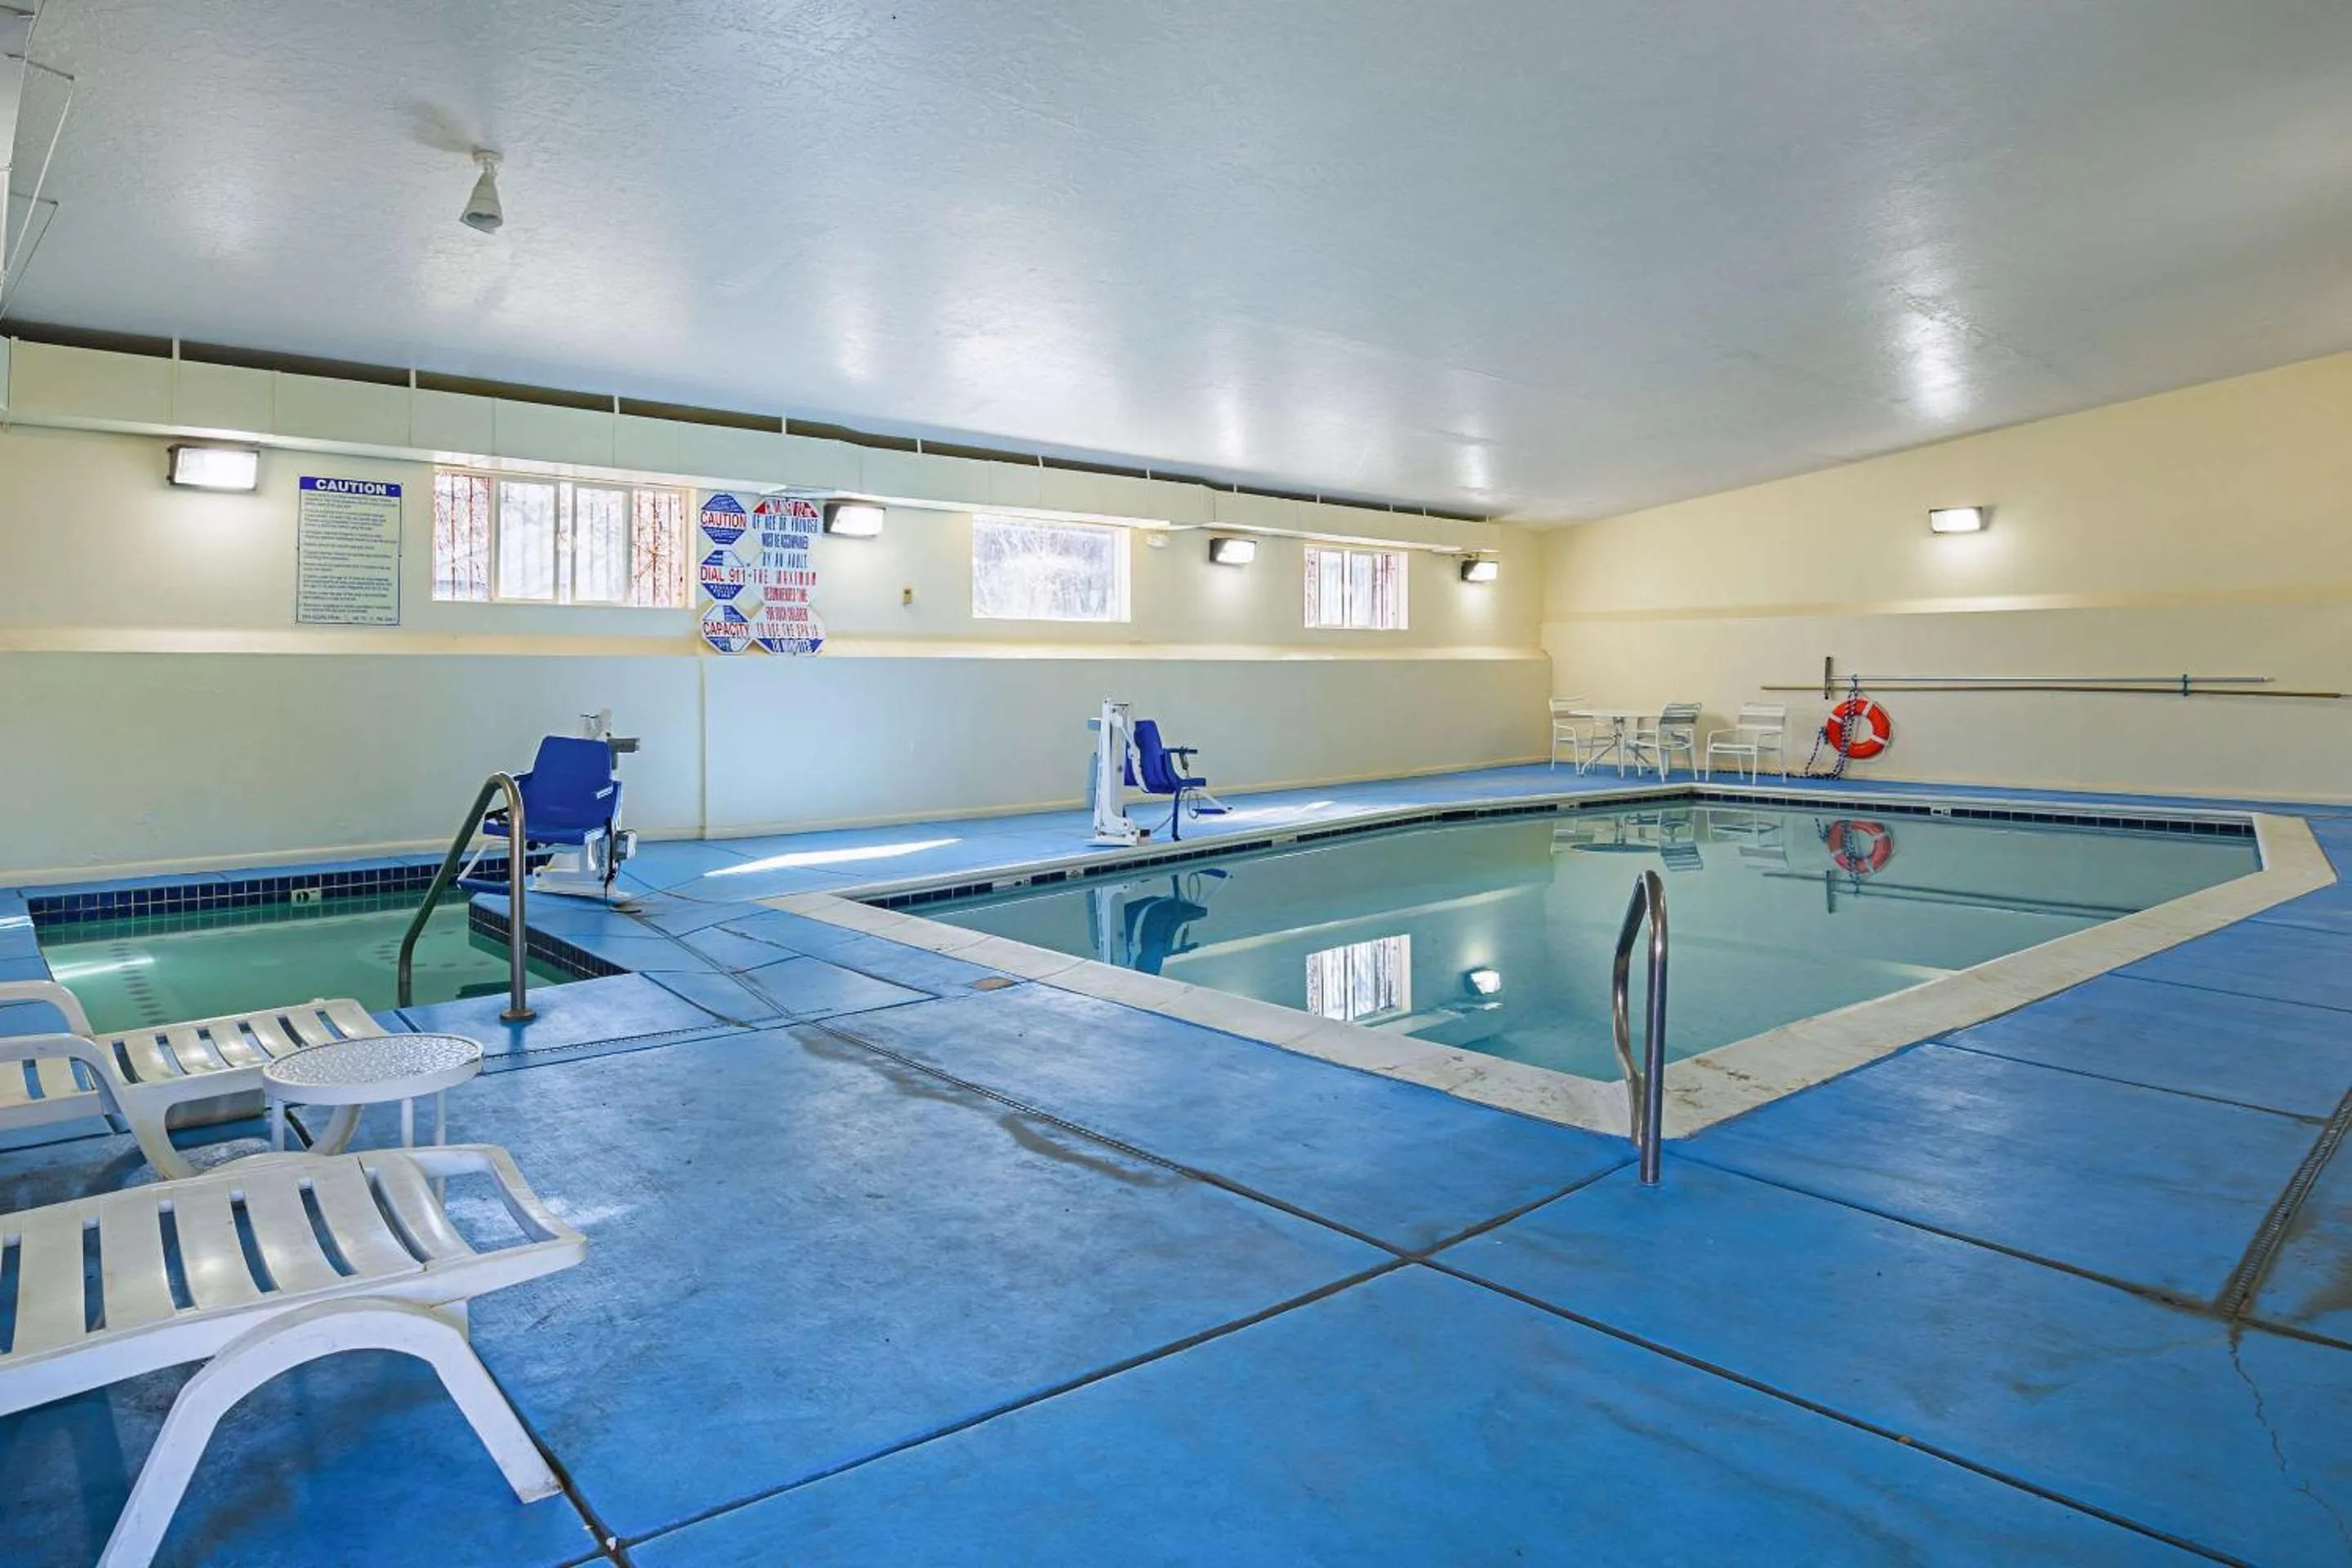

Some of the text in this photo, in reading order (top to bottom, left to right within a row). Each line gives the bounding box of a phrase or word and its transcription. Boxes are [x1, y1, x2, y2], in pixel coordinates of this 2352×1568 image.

[315, 479, 387, 495] CAUTION
[700, 511, 746, 528] CAUTION
[700, 566, 746, 583] DIAL 911
[703, 621, 749, 637] CAPACITY
